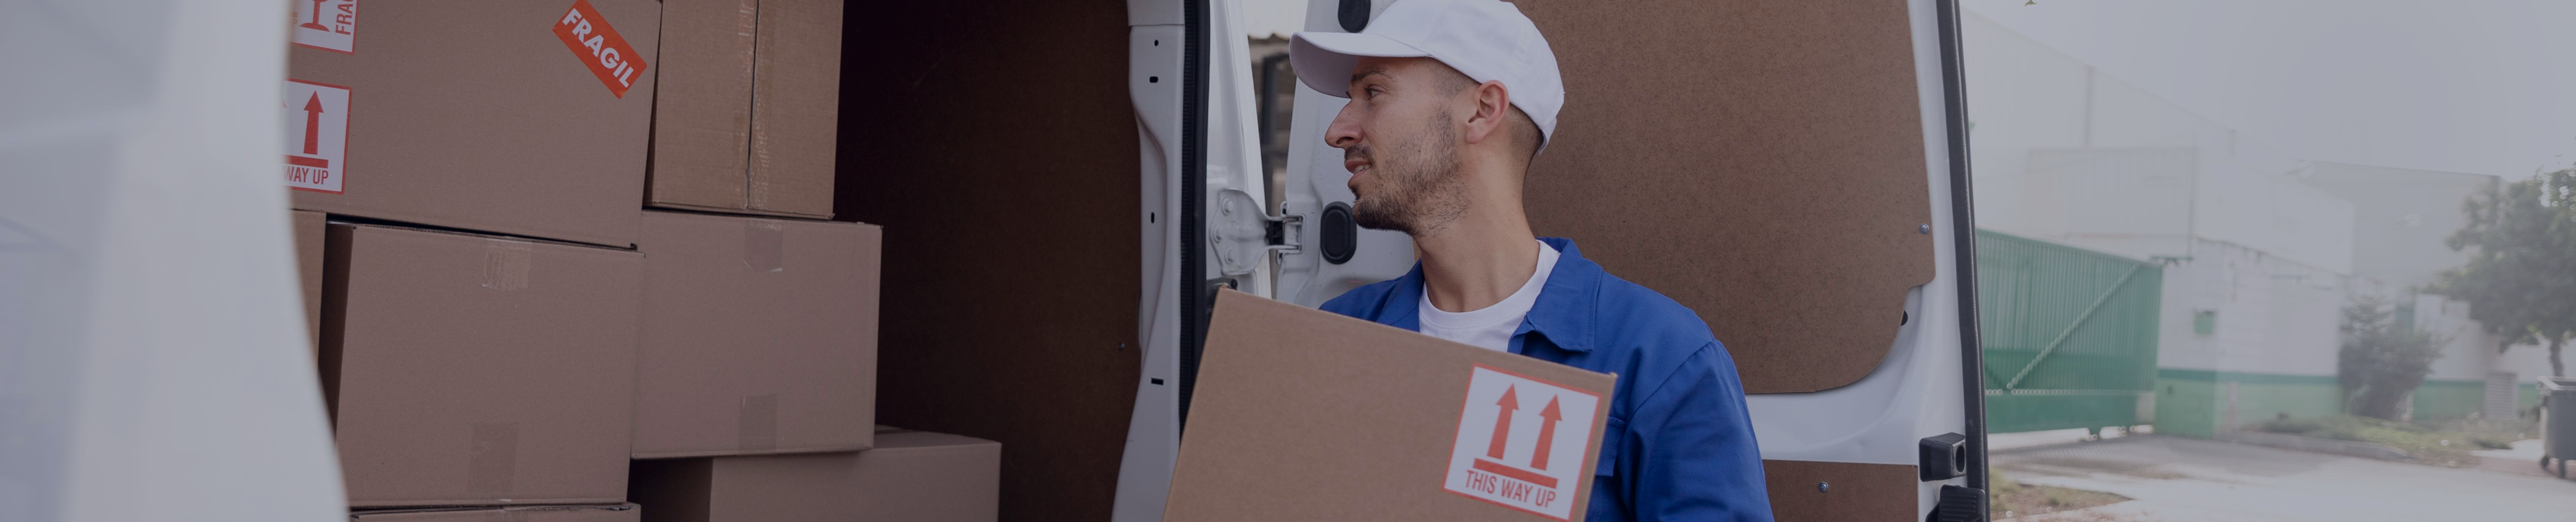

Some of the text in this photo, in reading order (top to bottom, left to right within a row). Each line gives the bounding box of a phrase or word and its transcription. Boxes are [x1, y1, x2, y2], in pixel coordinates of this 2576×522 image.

[335, 0, 354, 35] FRA
[562, 8, 634, 88] FRAGIL
[284, 166, 329, 185] WAY UP
[1466, 470, 1556, 508] THIS WAY UP
